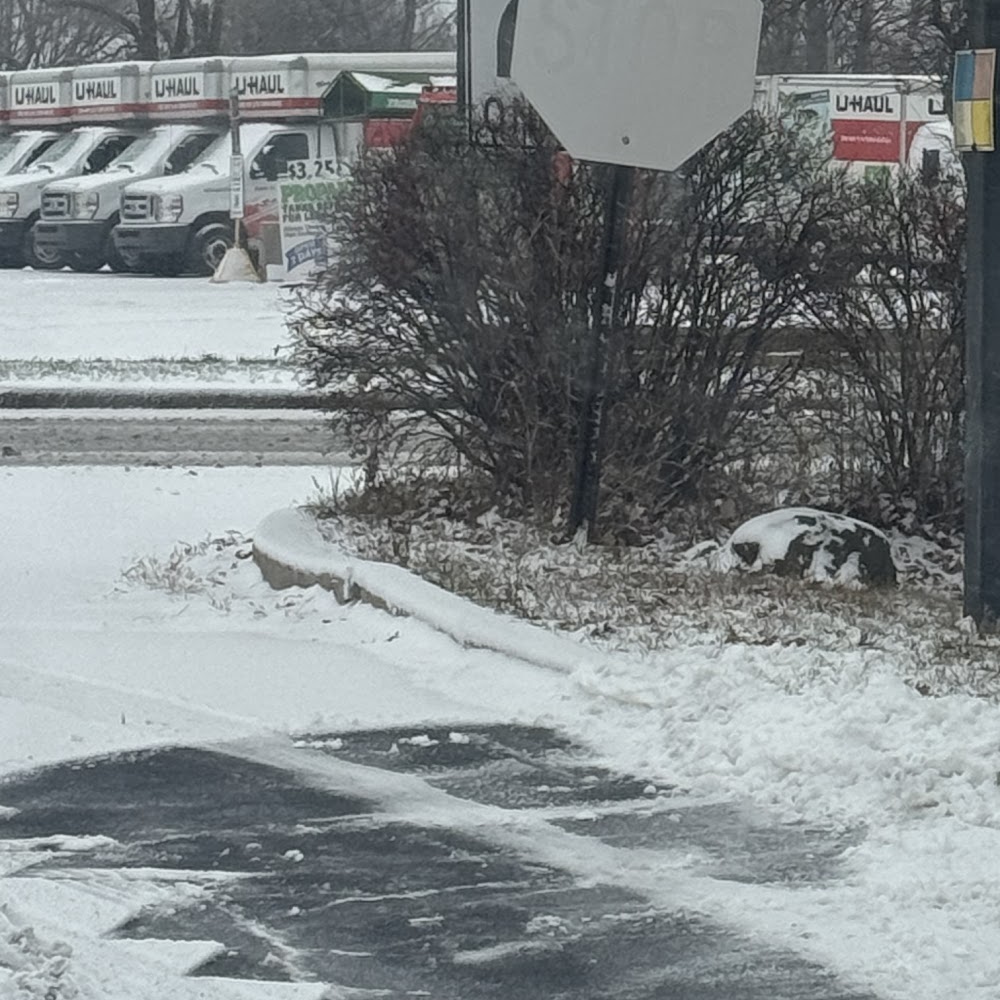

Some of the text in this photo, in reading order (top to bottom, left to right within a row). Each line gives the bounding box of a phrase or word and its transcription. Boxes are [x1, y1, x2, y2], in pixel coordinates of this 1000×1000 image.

[15, 85, 56, 105] U-HAUL
[76, 80, 117, 100] U-HAUL
[155, 76, 200, 98] U-HAUL
[836, 95, 894, 113] U-HAUL
